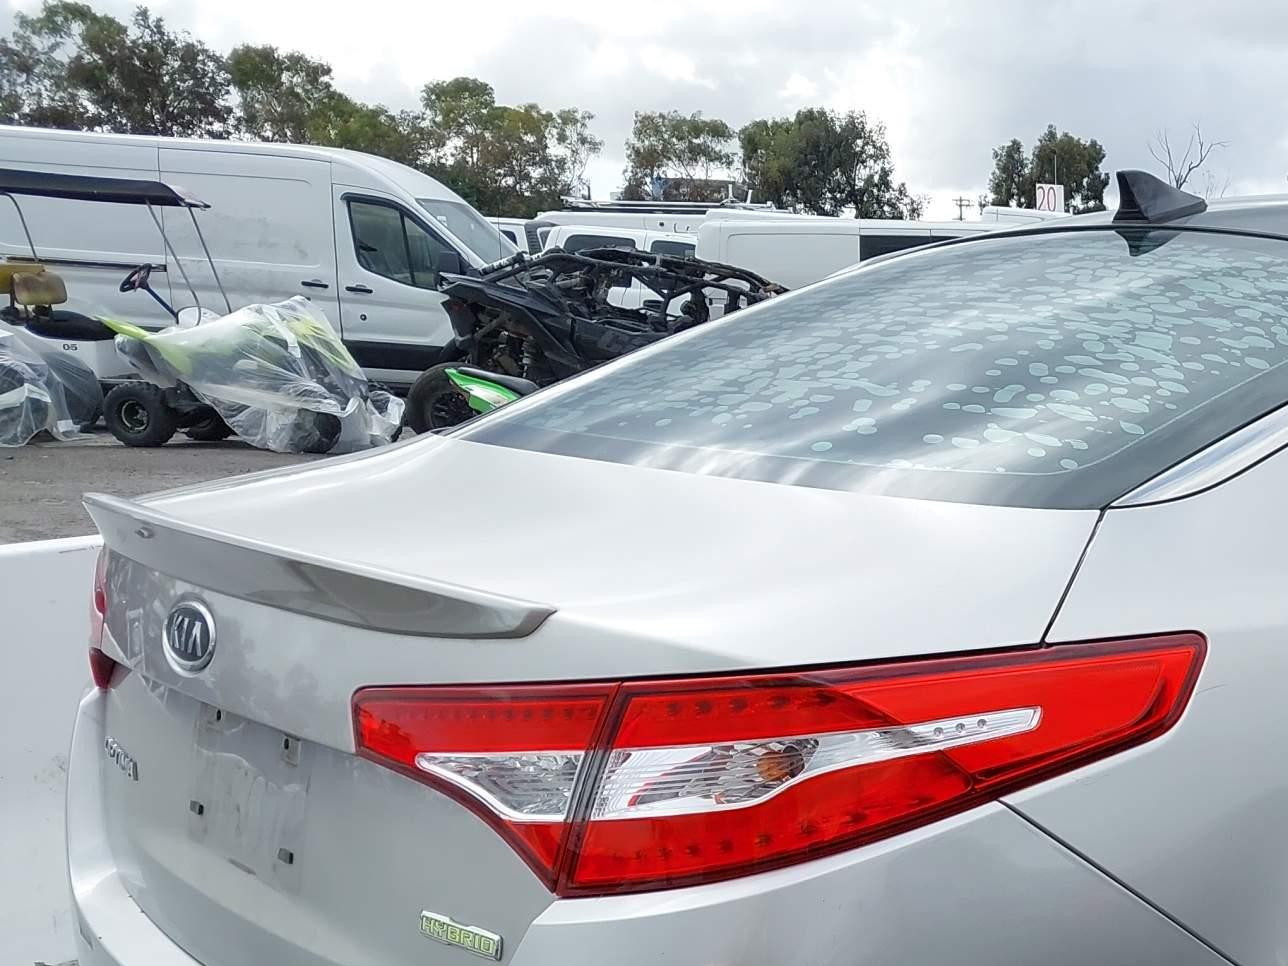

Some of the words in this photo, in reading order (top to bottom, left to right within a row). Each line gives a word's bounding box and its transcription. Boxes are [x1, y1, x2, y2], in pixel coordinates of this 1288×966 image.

[1037, 185, 1057, 212] 20
[62, 343, 78, 351] 05
[169, 611, 202, 657] KIA
[422, 916, 495, 955] HYBRID
